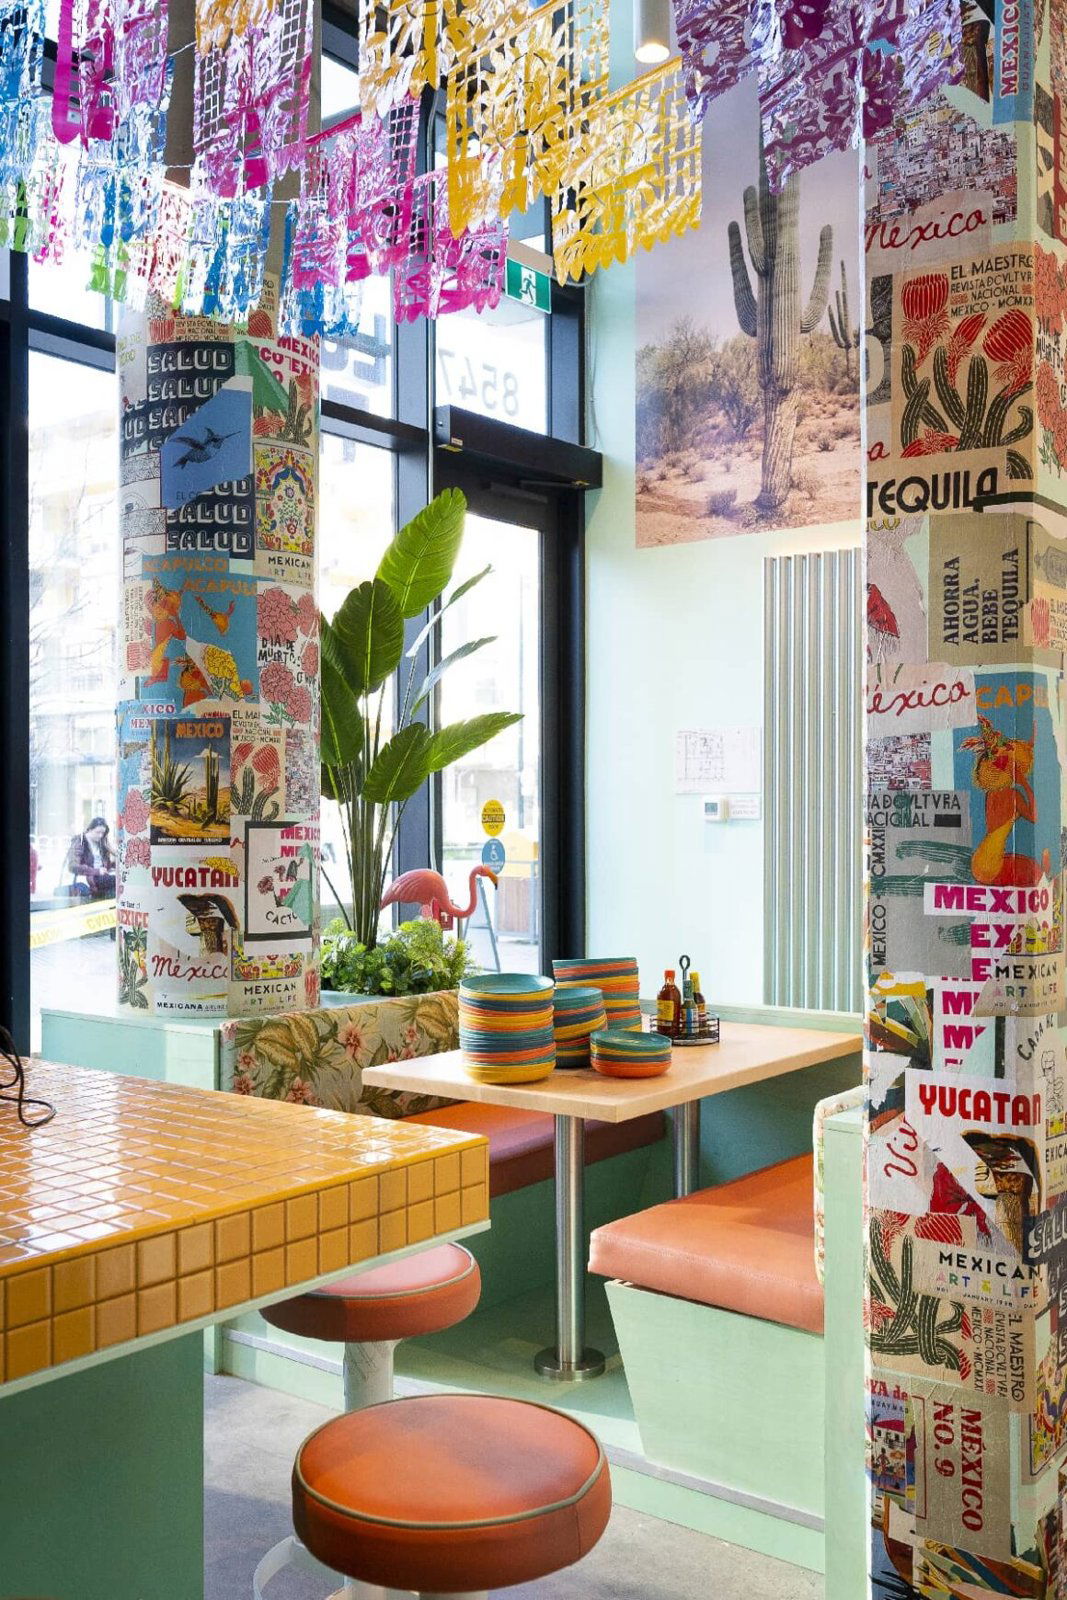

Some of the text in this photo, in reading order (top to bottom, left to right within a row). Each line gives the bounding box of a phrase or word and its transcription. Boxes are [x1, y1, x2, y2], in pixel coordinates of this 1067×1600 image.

[1001, 0, 1019, 97] MEXIC
[951, 264, 967, 281] EL
[971, 285, 1020, 301] NACIONAL
[951, 302, 989, 318] MEXICO
[148, 348, 232, 374] SALUD
[167, 530, 252, 553] SALUD
[268, 556, 311, 569] MEXICAN
[943, 556, 961, 646] AHORRA
[1002, 548, 1022, 644] TEQUILA
[963, 578, 981, 645] AGUA,
[982, 589, 998, 644] BEBE
[258, 649, 303, 667] MUERTOS
[286, 640, 295, 652] DE
[232, 709, 243, 719] EL
[175, 722, 225, 739] MEXICO
[934, 885, 1050, 914] MEXICO
[872, 904, 887, 966] MEXICO
[995, 962, 1057, 980] MEXICAN
[244, 983, 296, 996] MEXICAN
[156, 1002, 203, 1011] MEXICANA
[918, 1083, 1041, 1126] YUCATAN
[939, 1251, 1040, 1281] MEXICAN
[936, 1271, 971, 1288] ART
[972, 1306, 983, 1344] MEXICO
[984, 1326, 995, 1377] NACIONAL
[1009, 1332, 1025, 1402] MAESTRO
[893, 1384, 909, 1401] de
[933, 1401, 955, 1478] NO. 9
[960, 1406, 985, 1532] MÉXICO
